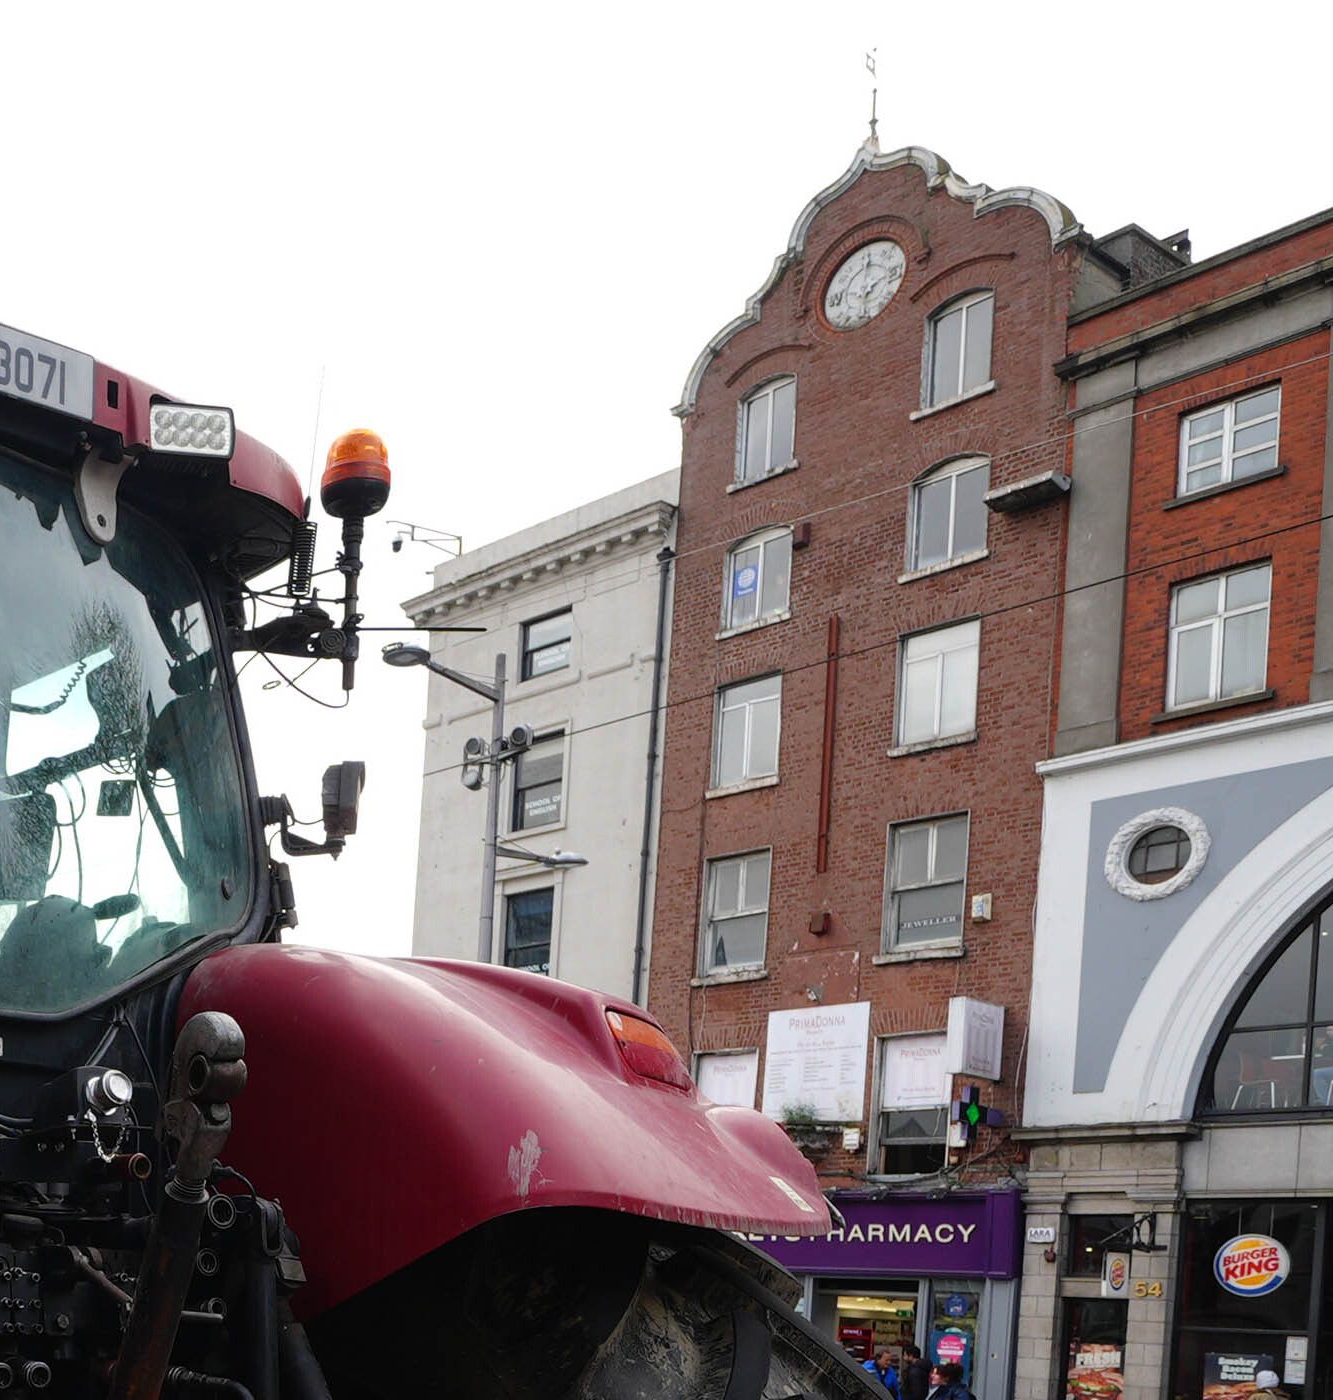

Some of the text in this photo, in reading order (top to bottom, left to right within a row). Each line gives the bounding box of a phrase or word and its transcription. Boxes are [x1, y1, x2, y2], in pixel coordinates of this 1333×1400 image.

[901, 915, 957, 930] JEWELLER
[810, 1223, 976, 1243] HARMACY
[1223, 1247, 1278, 1267] BURGER
[1225, 1257, 1280, 1282] KING
[1134, 1280, 1162, 1298] 54
